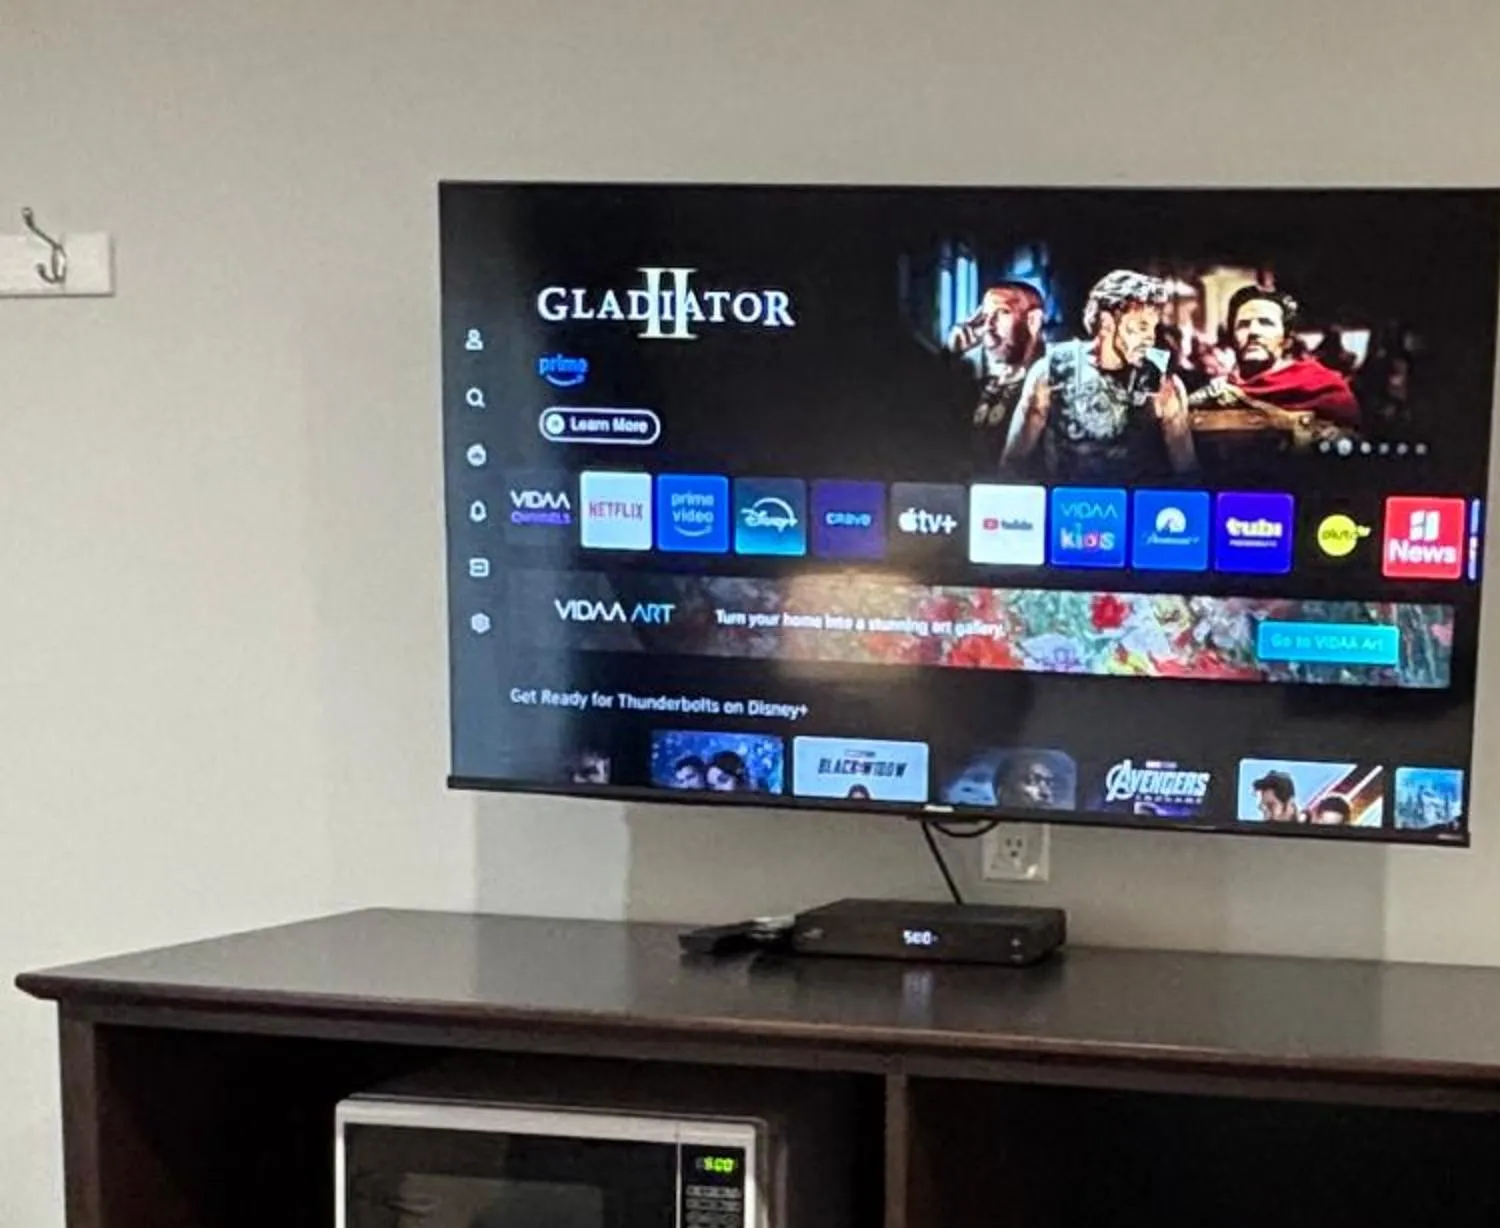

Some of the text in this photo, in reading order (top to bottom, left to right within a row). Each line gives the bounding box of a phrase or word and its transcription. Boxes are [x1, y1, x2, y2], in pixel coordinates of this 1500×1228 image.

[537, 287, 796, 327] GLADIATOR
[539, 355, 589, 376] prime
[570, 416, 649, 434] Learn More
[510, 490, 571, 510] VIDAA
[671, 492, 714, 508] prime
[588, 502, 644, 521] NETFLIX
[672, 508, 714, 523] video
[1226, 517, 1283, 538] tubi
[1388, 539, 1457, 564] News
[554, 599, 675, 624] VIDAA ART
[716, 609, 746, 625] Turn
[748, 612, 780, 628] your
[782, 613, 822, 628] home
[824, 615, 853, 631] into
[856, 618, 867, 631] a
[868, 618, 929, 635] stunning
[931, 620, 952, 633] art
[1271, 633, 1292, 647] Go
[1296, 635, 1311, 648] to
[1361, 637, 1383, 651] Art
[510, 688, 808, 720] Get Ready for Thunderbolts on Disney+
